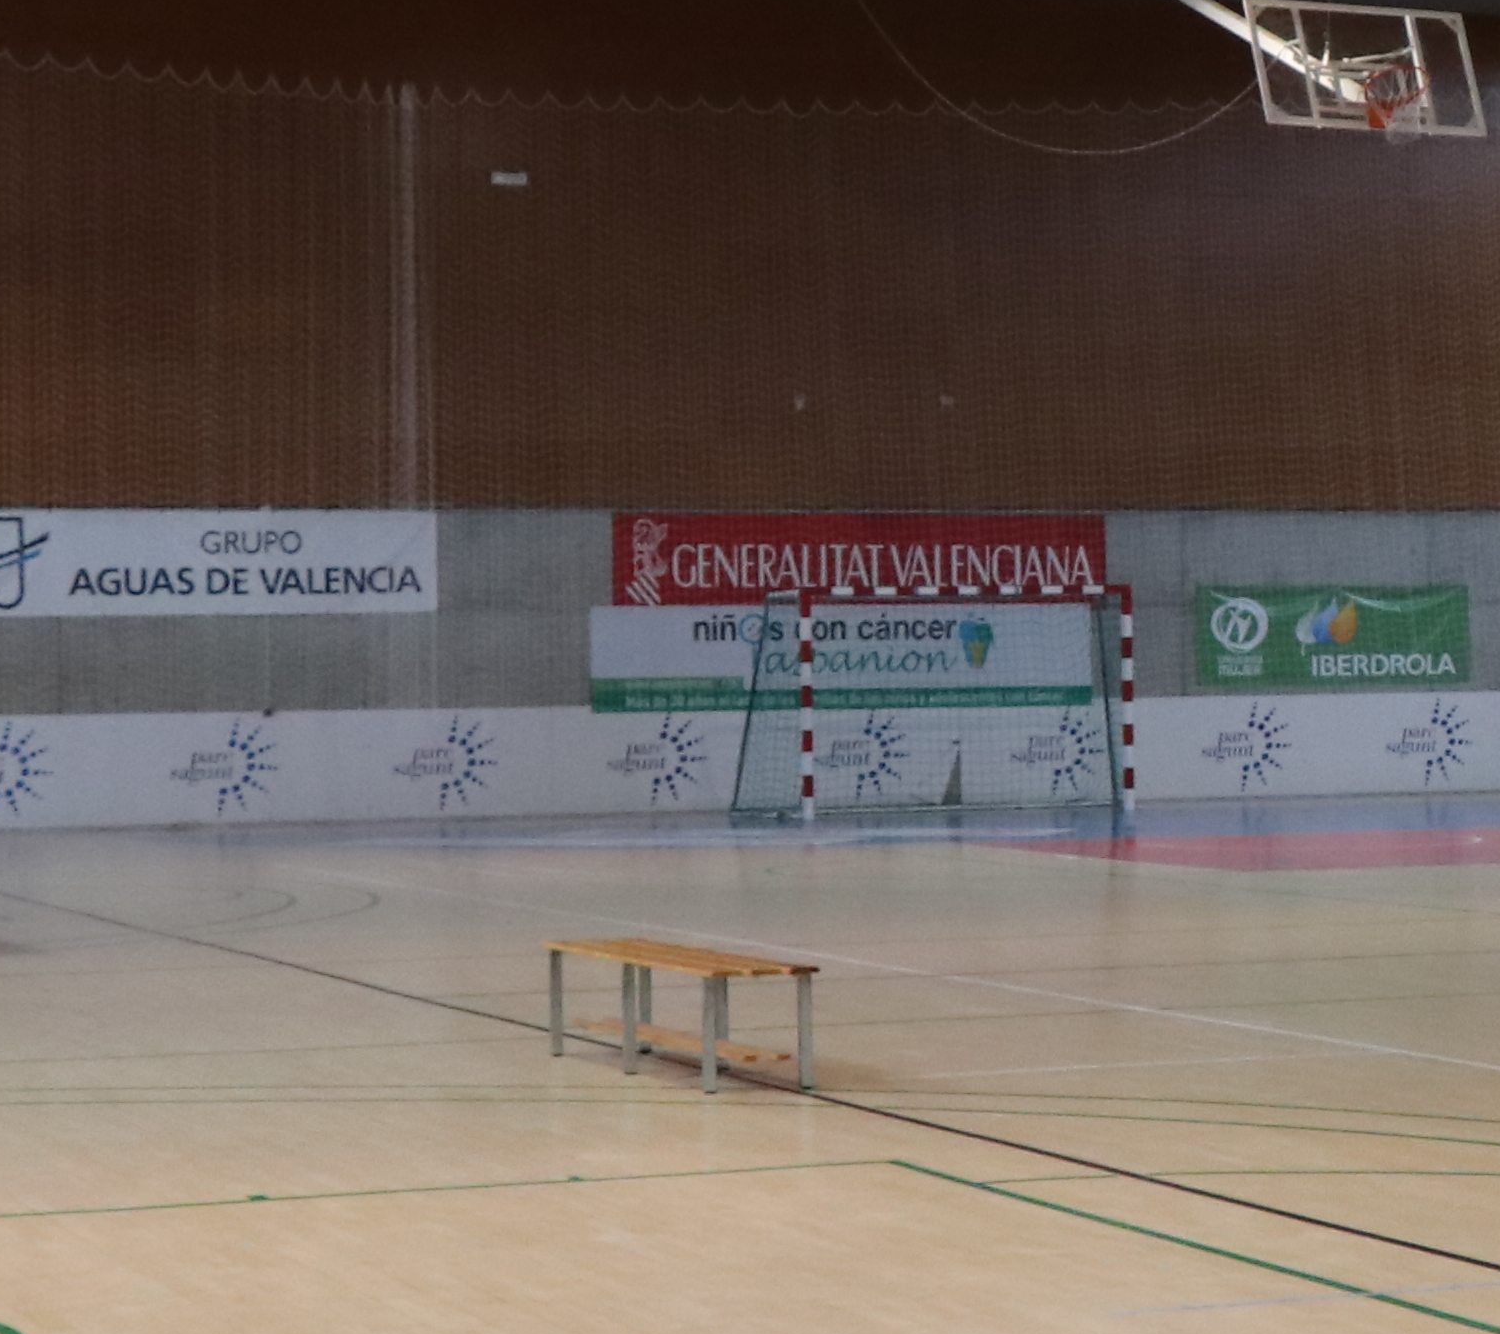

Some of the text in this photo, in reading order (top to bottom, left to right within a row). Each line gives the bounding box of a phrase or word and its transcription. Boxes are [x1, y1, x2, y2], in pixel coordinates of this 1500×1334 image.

[200, 530, 302, 555] GRUPO
[68, 566, 422, 597] AGUAS DE VALENCIA
[671, 543, 1096, 589] GENERALITAT VALENCIANA
[857, 613, 958, 644] cáncer
[1311, 652, 1457, 677] IBERDROLA
